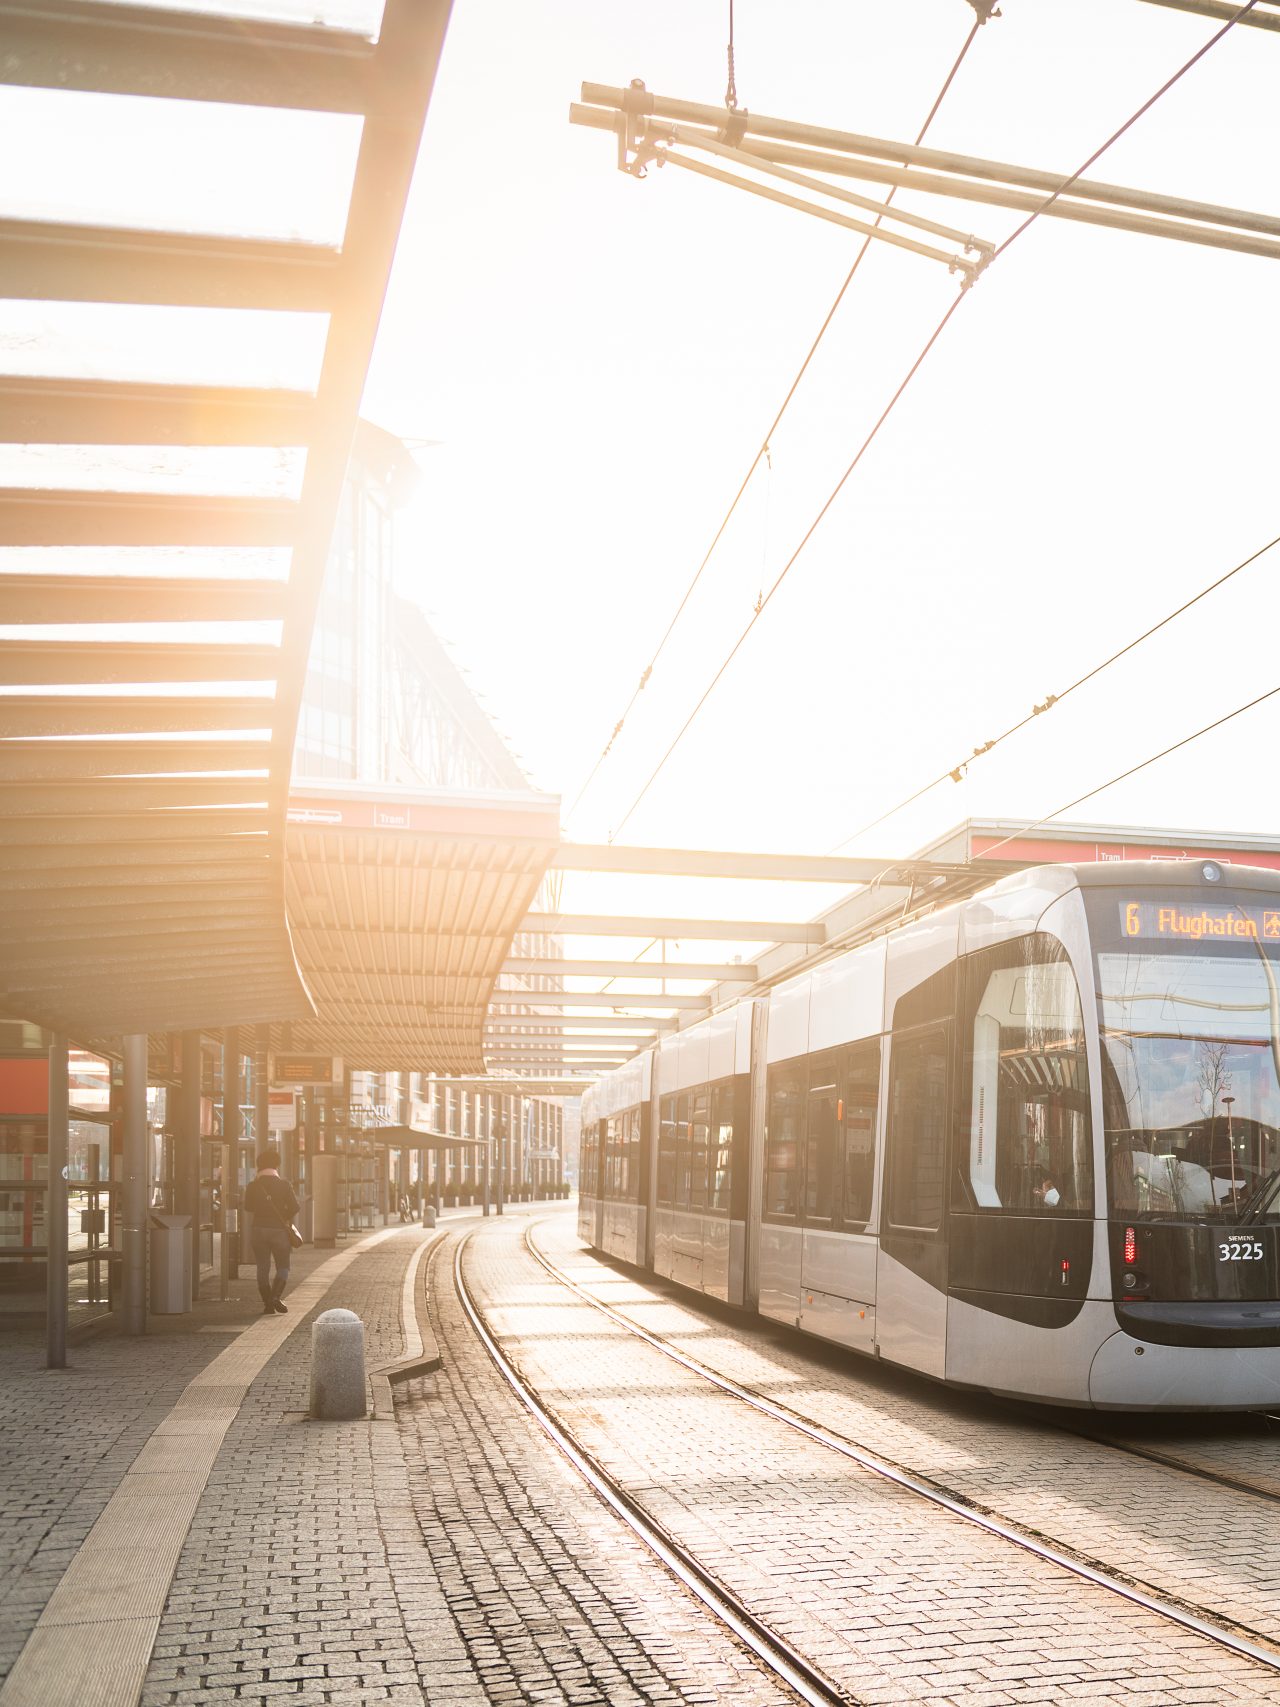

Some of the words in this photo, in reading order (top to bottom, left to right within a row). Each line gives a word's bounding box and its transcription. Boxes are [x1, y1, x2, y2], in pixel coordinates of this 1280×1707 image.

[380, 813, 405, 825] Tram
[1100, 852, 1121, 862] Tram
[1126, 903, 1141, 936] 6
[1159, 908, 1258, 939] Flughafen
[1218, 1243, 1264, 1261] 3225
